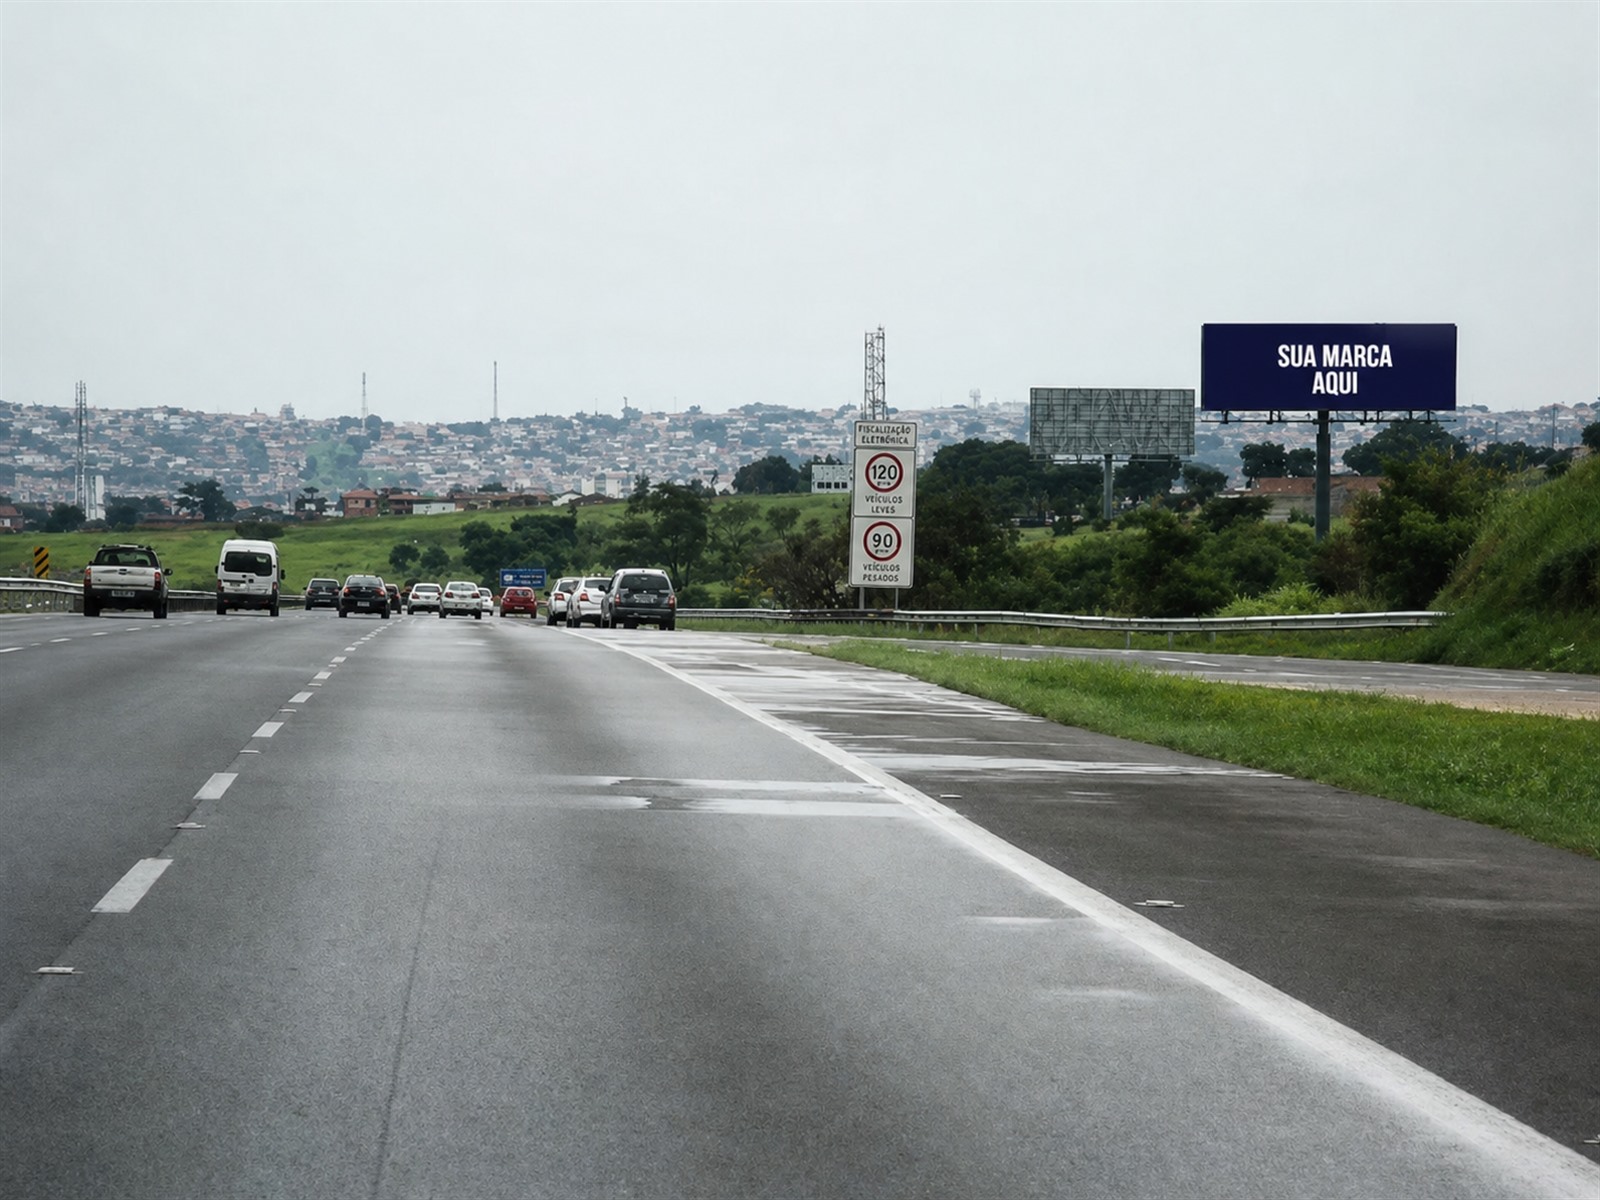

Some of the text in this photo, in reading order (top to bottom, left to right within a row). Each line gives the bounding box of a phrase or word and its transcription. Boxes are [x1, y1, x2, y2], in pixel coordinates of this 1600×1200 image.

[1278, 344, 1393, 368] SUA MARCA
[1312, 371, 1358, 396] AQUI
[858, 424, 911, 435] FISCALIZAÇÃO
[871, 464, 898, 480] 120
[865, 493, 903, 504] VEÍCULOS
[871, 505, 896, 514] LEVES
[872, 533, 893, 548] 90
[862, 561, 901, 572] VEÍCULOS
[862, 573, 899, 582] PESADOS
